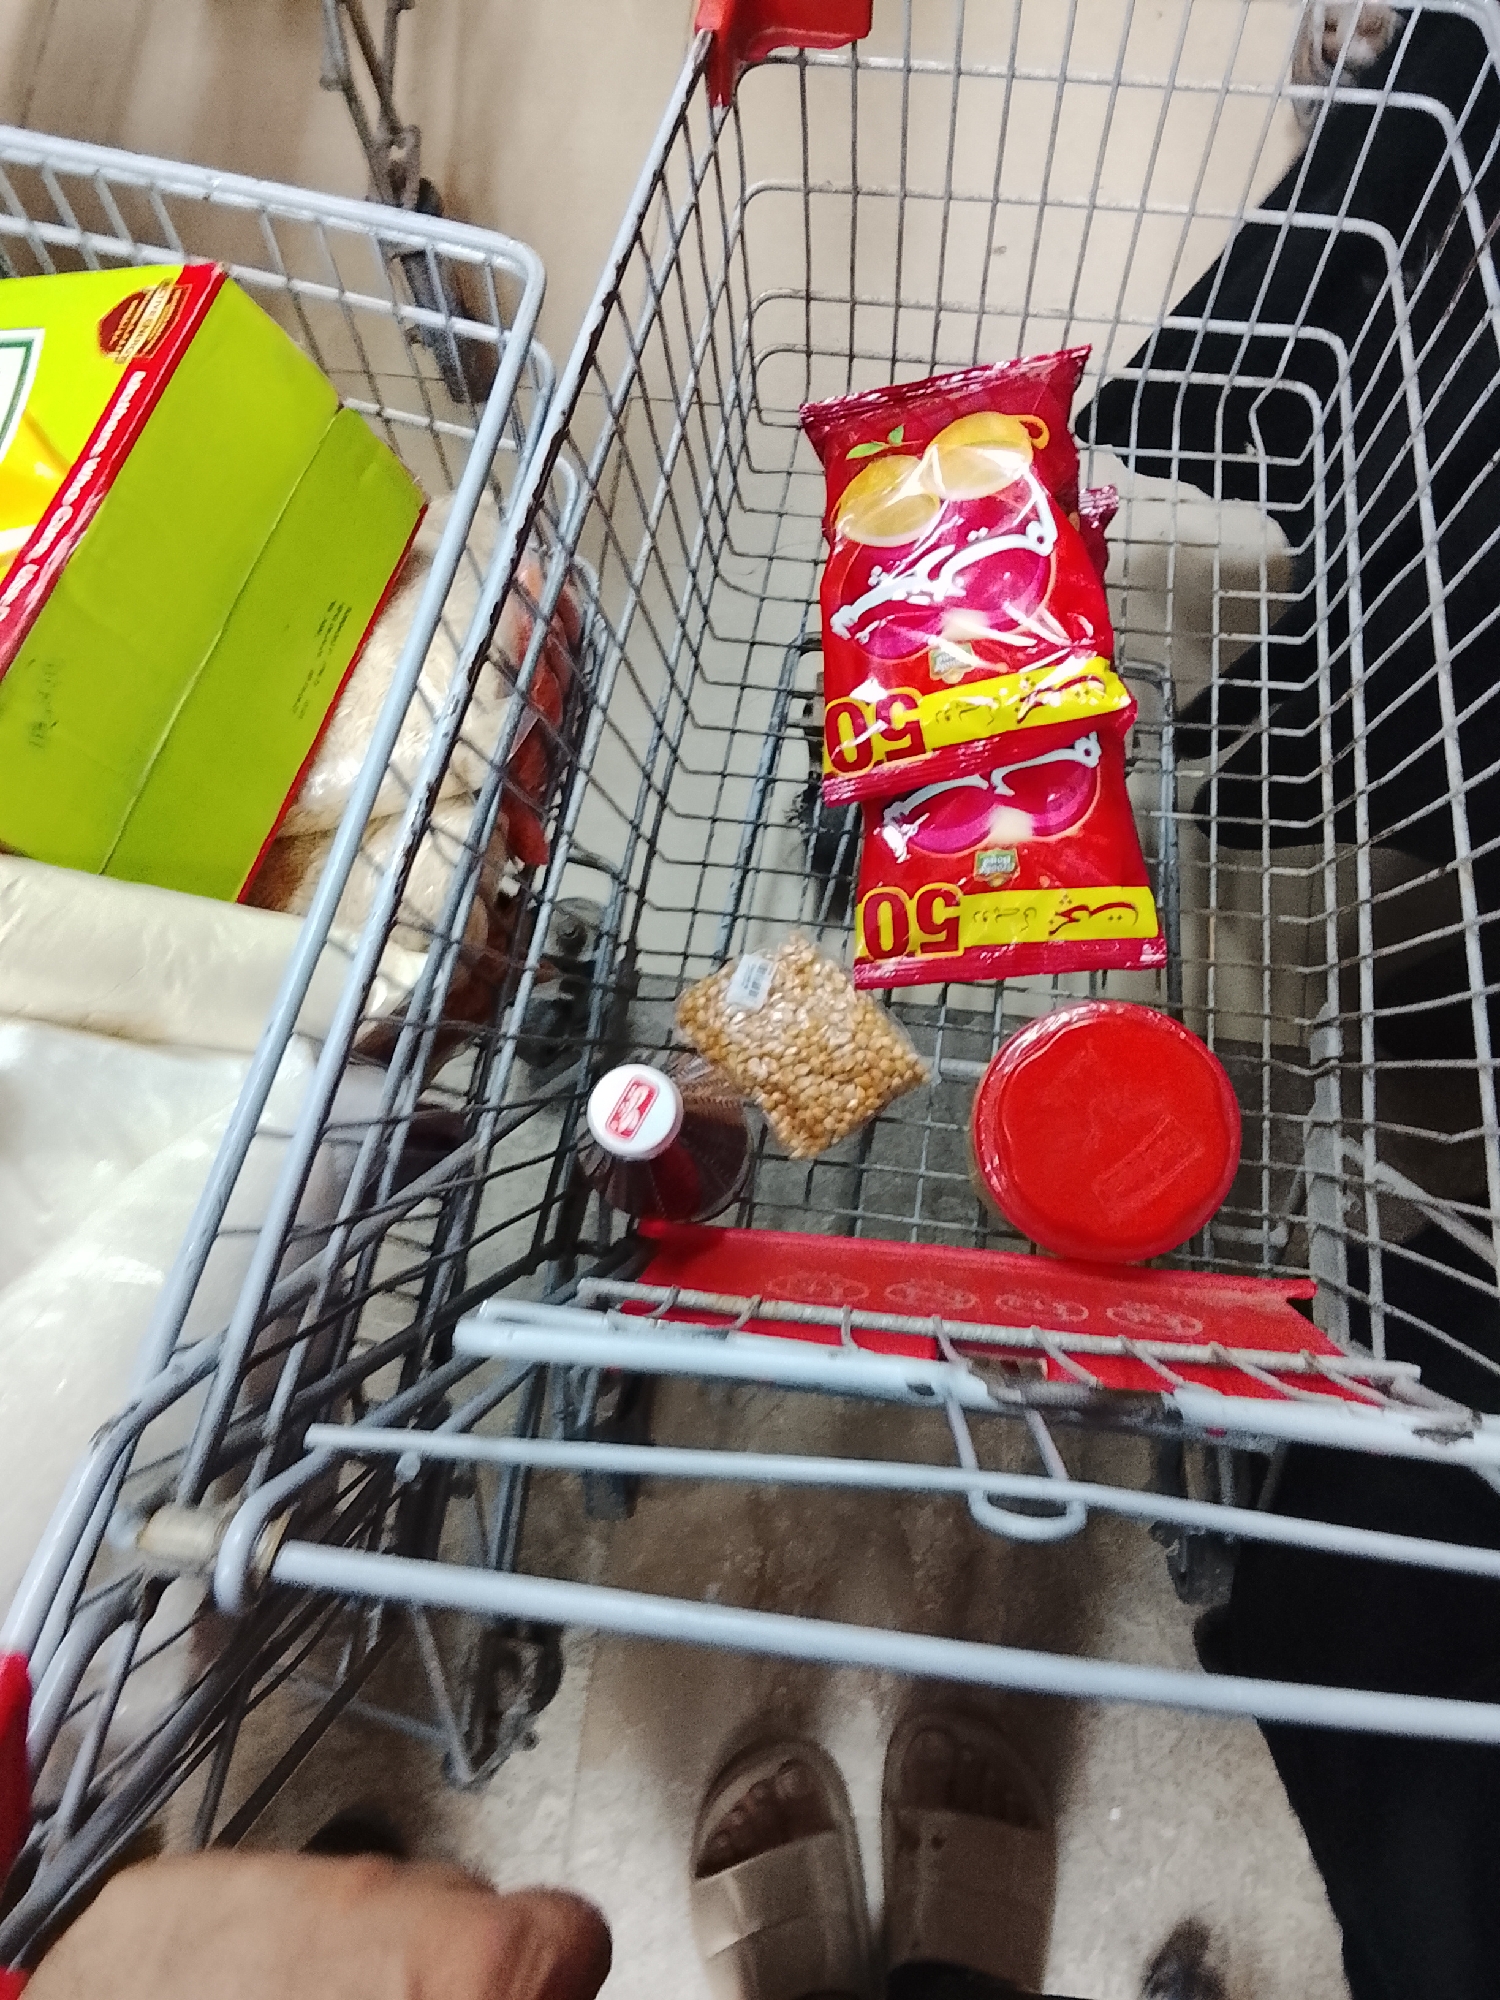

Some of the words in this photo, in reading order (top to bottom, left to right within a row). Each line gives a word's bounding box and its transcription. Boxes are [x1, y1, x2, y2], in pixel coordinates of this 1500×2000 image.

[825, 690, 927, 773] 50
[860, 885, 962, 957] 50
[1048, 894, 1139, 935] بچت
